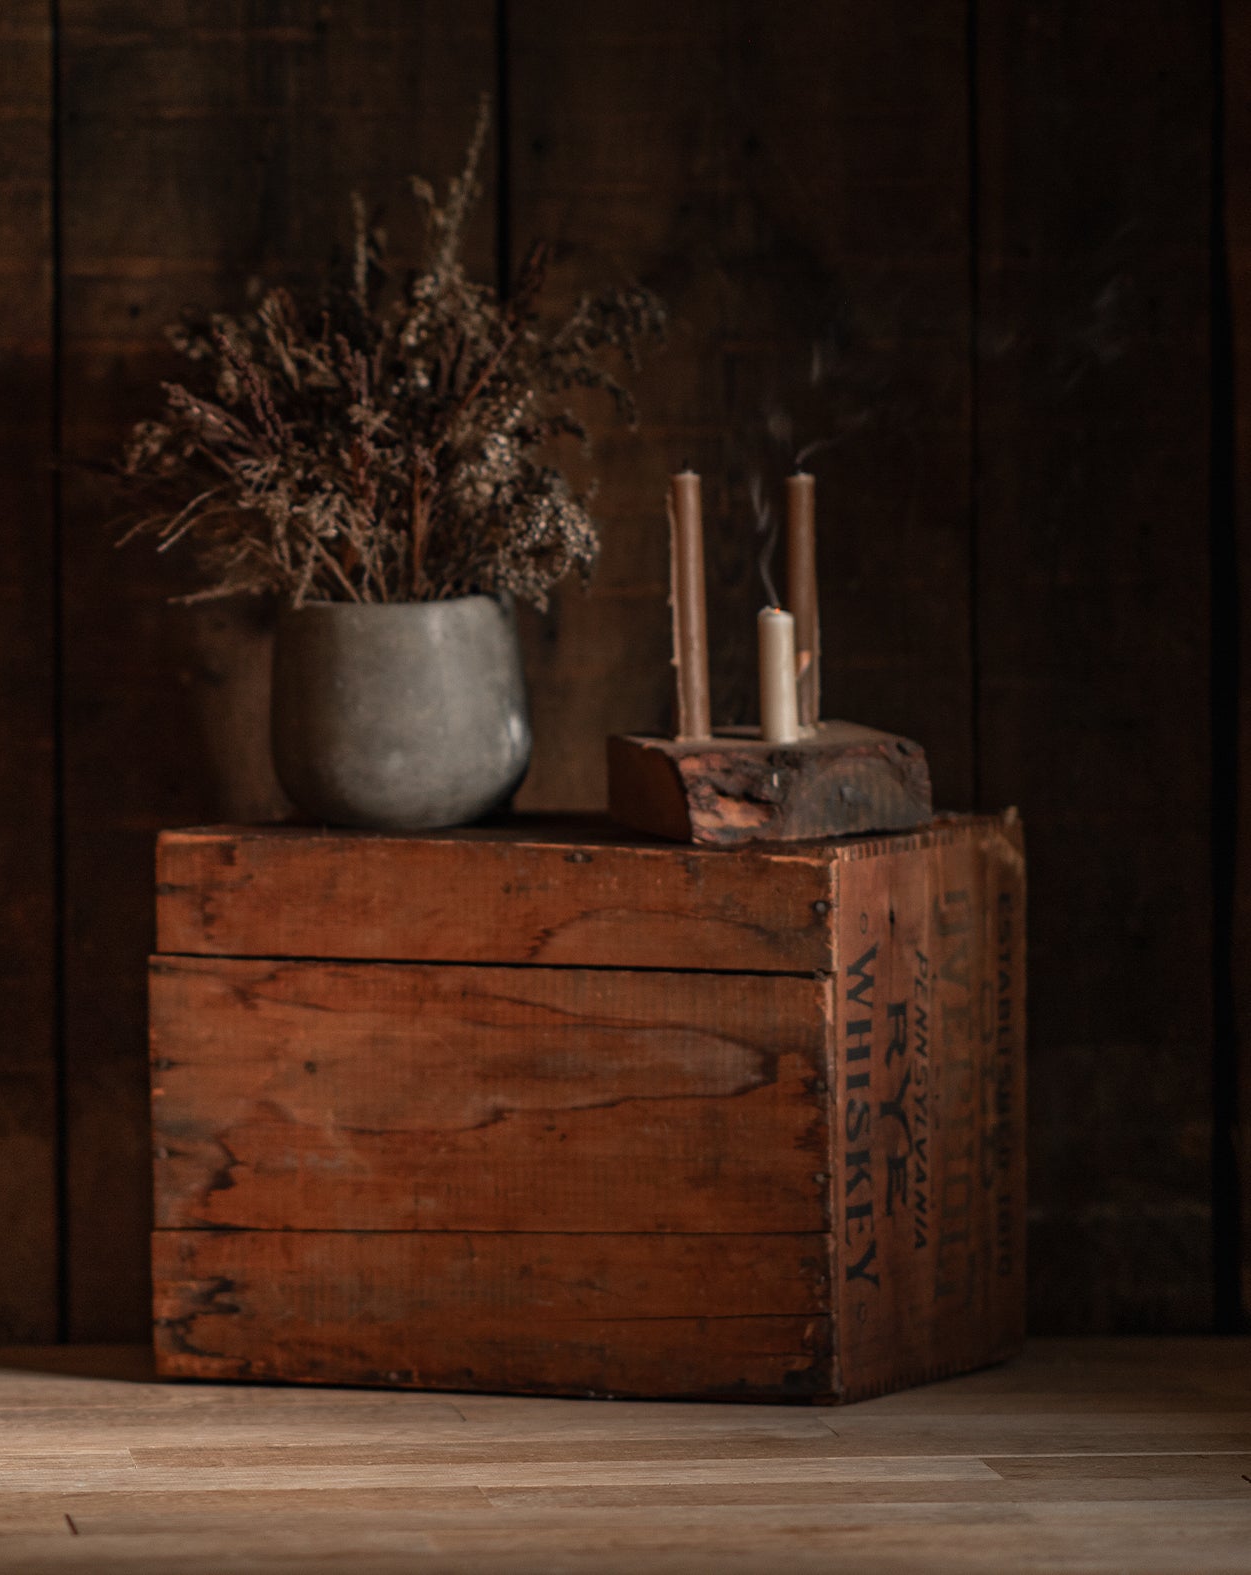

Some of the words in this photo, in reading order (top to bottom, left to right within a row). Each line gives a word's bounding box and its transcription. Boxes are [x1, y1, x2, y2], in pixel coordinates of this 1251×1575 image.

[843, 942, 881, 1290] WHISKEY
[879, 999, 913, 1218] RYE
[914, 950, 931, 1251] PENNSYLVANIA
